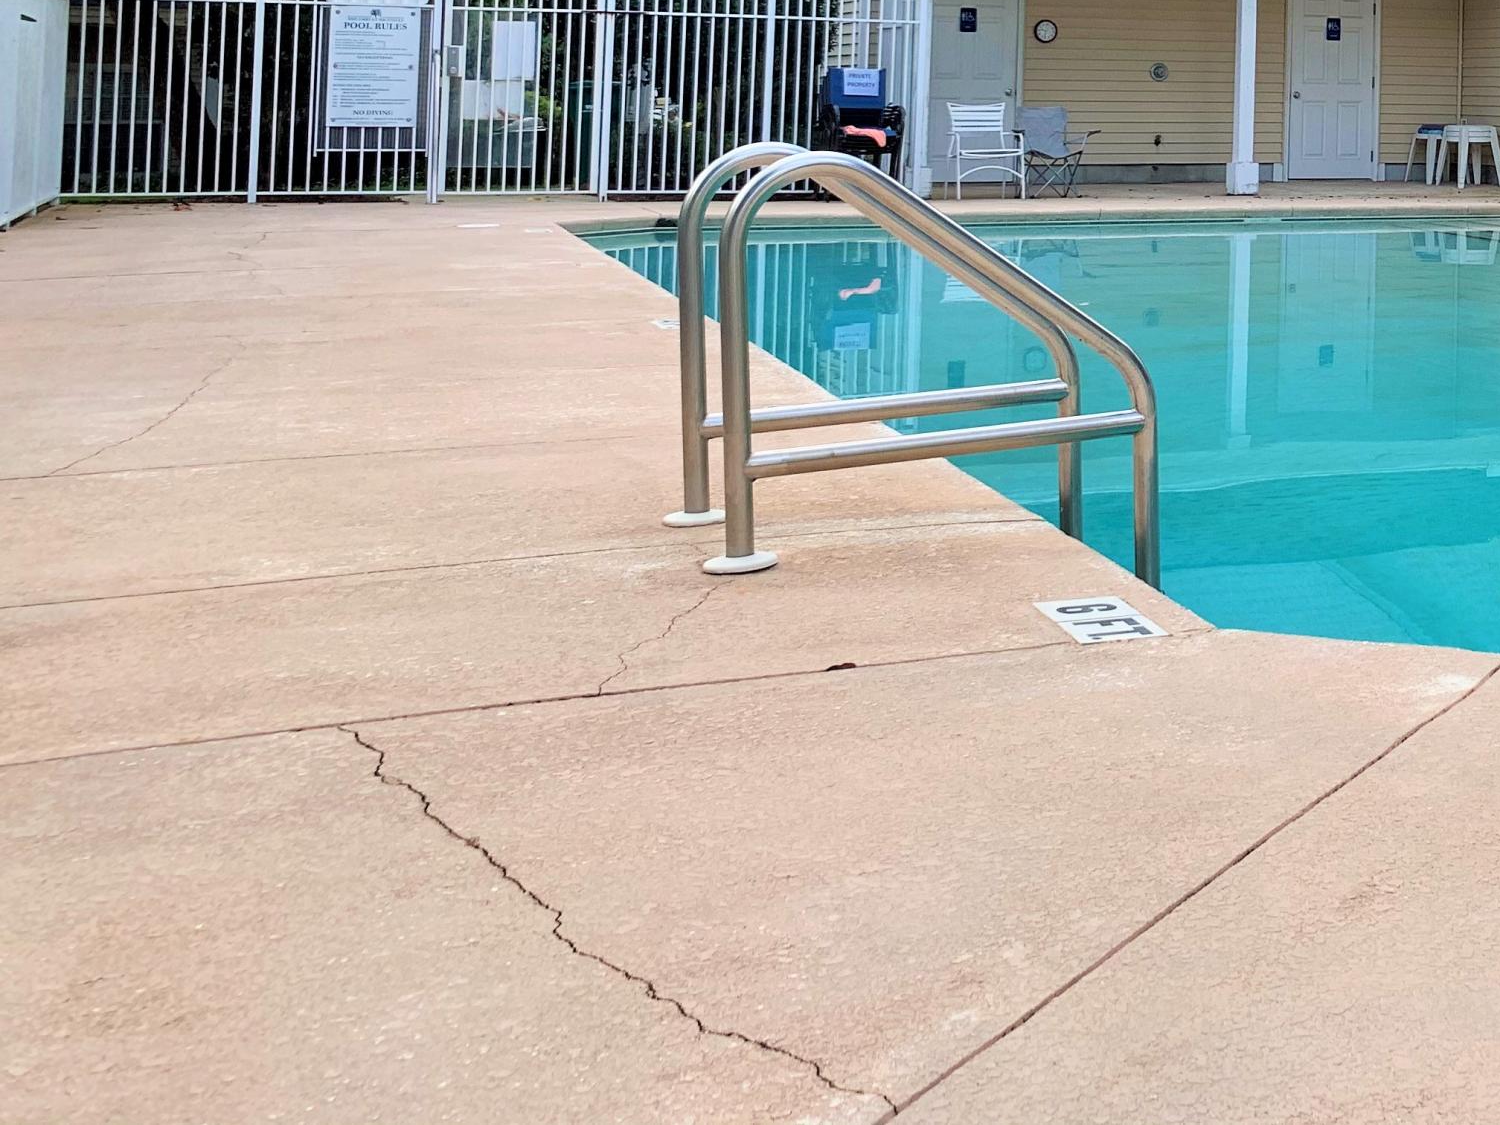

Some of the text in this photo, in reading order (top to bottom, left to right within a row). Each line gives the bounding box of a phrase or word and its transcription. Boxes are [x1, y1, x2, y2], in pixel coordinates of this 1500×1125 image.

[344, 21, 408, 31] POOL RULES
[1056, 603, 1117, 614] 6
